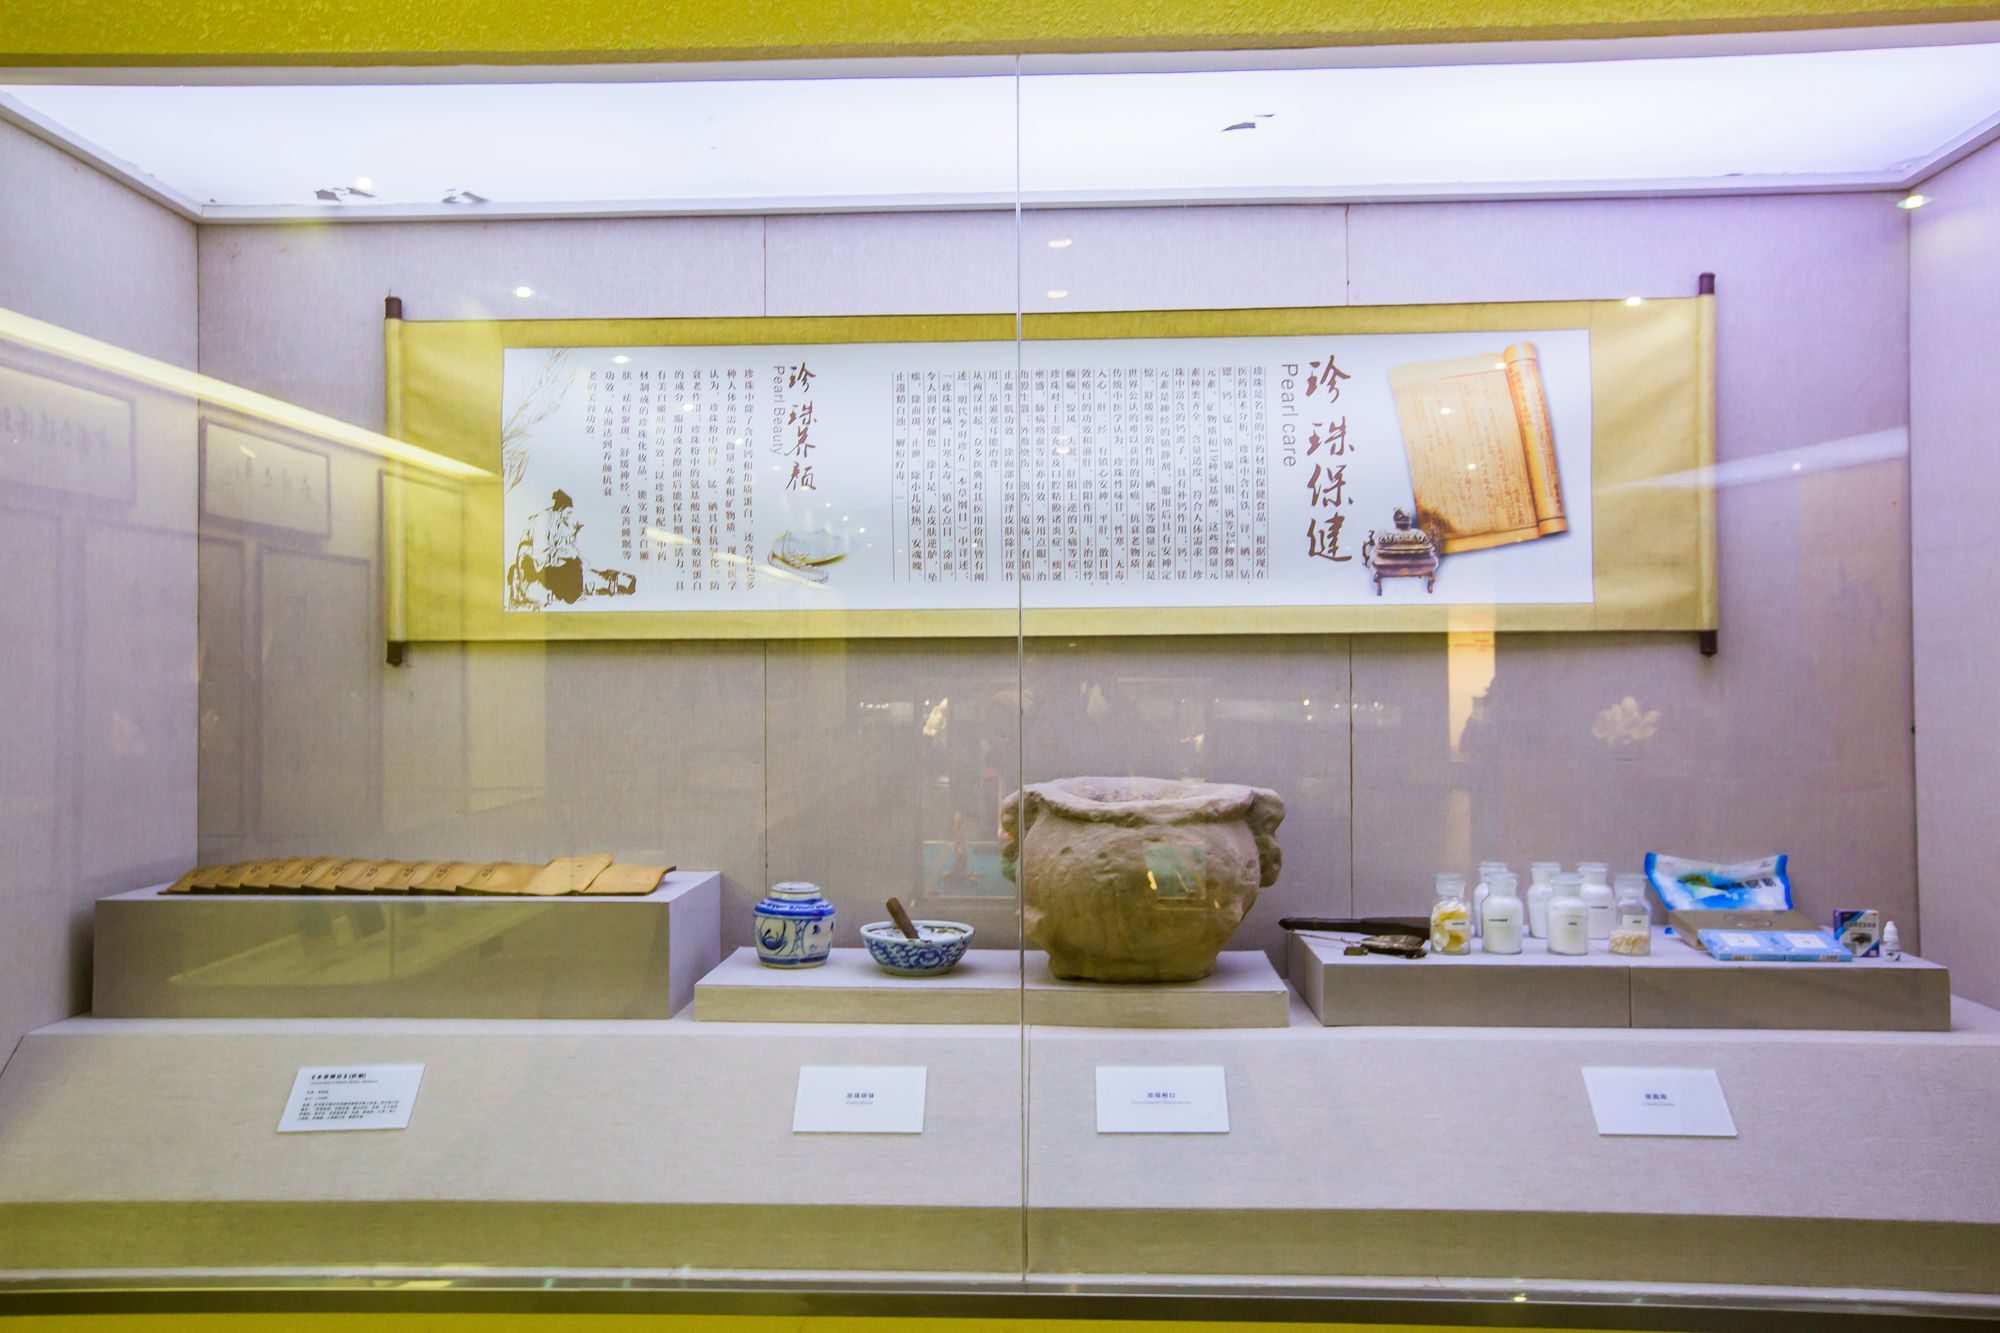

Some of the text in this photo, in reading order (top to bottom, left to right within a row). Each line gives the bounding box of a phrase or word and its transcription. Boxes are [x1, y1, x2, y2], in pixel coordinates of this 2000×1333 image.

[770, 366, 786, 456] Pearl Beauty
[784, 362, 817, 490] 珍珠养颜
[1281, 364, 1299, 468] Pearl care
[1305, 354, 1355, 562] 珍珠保健
